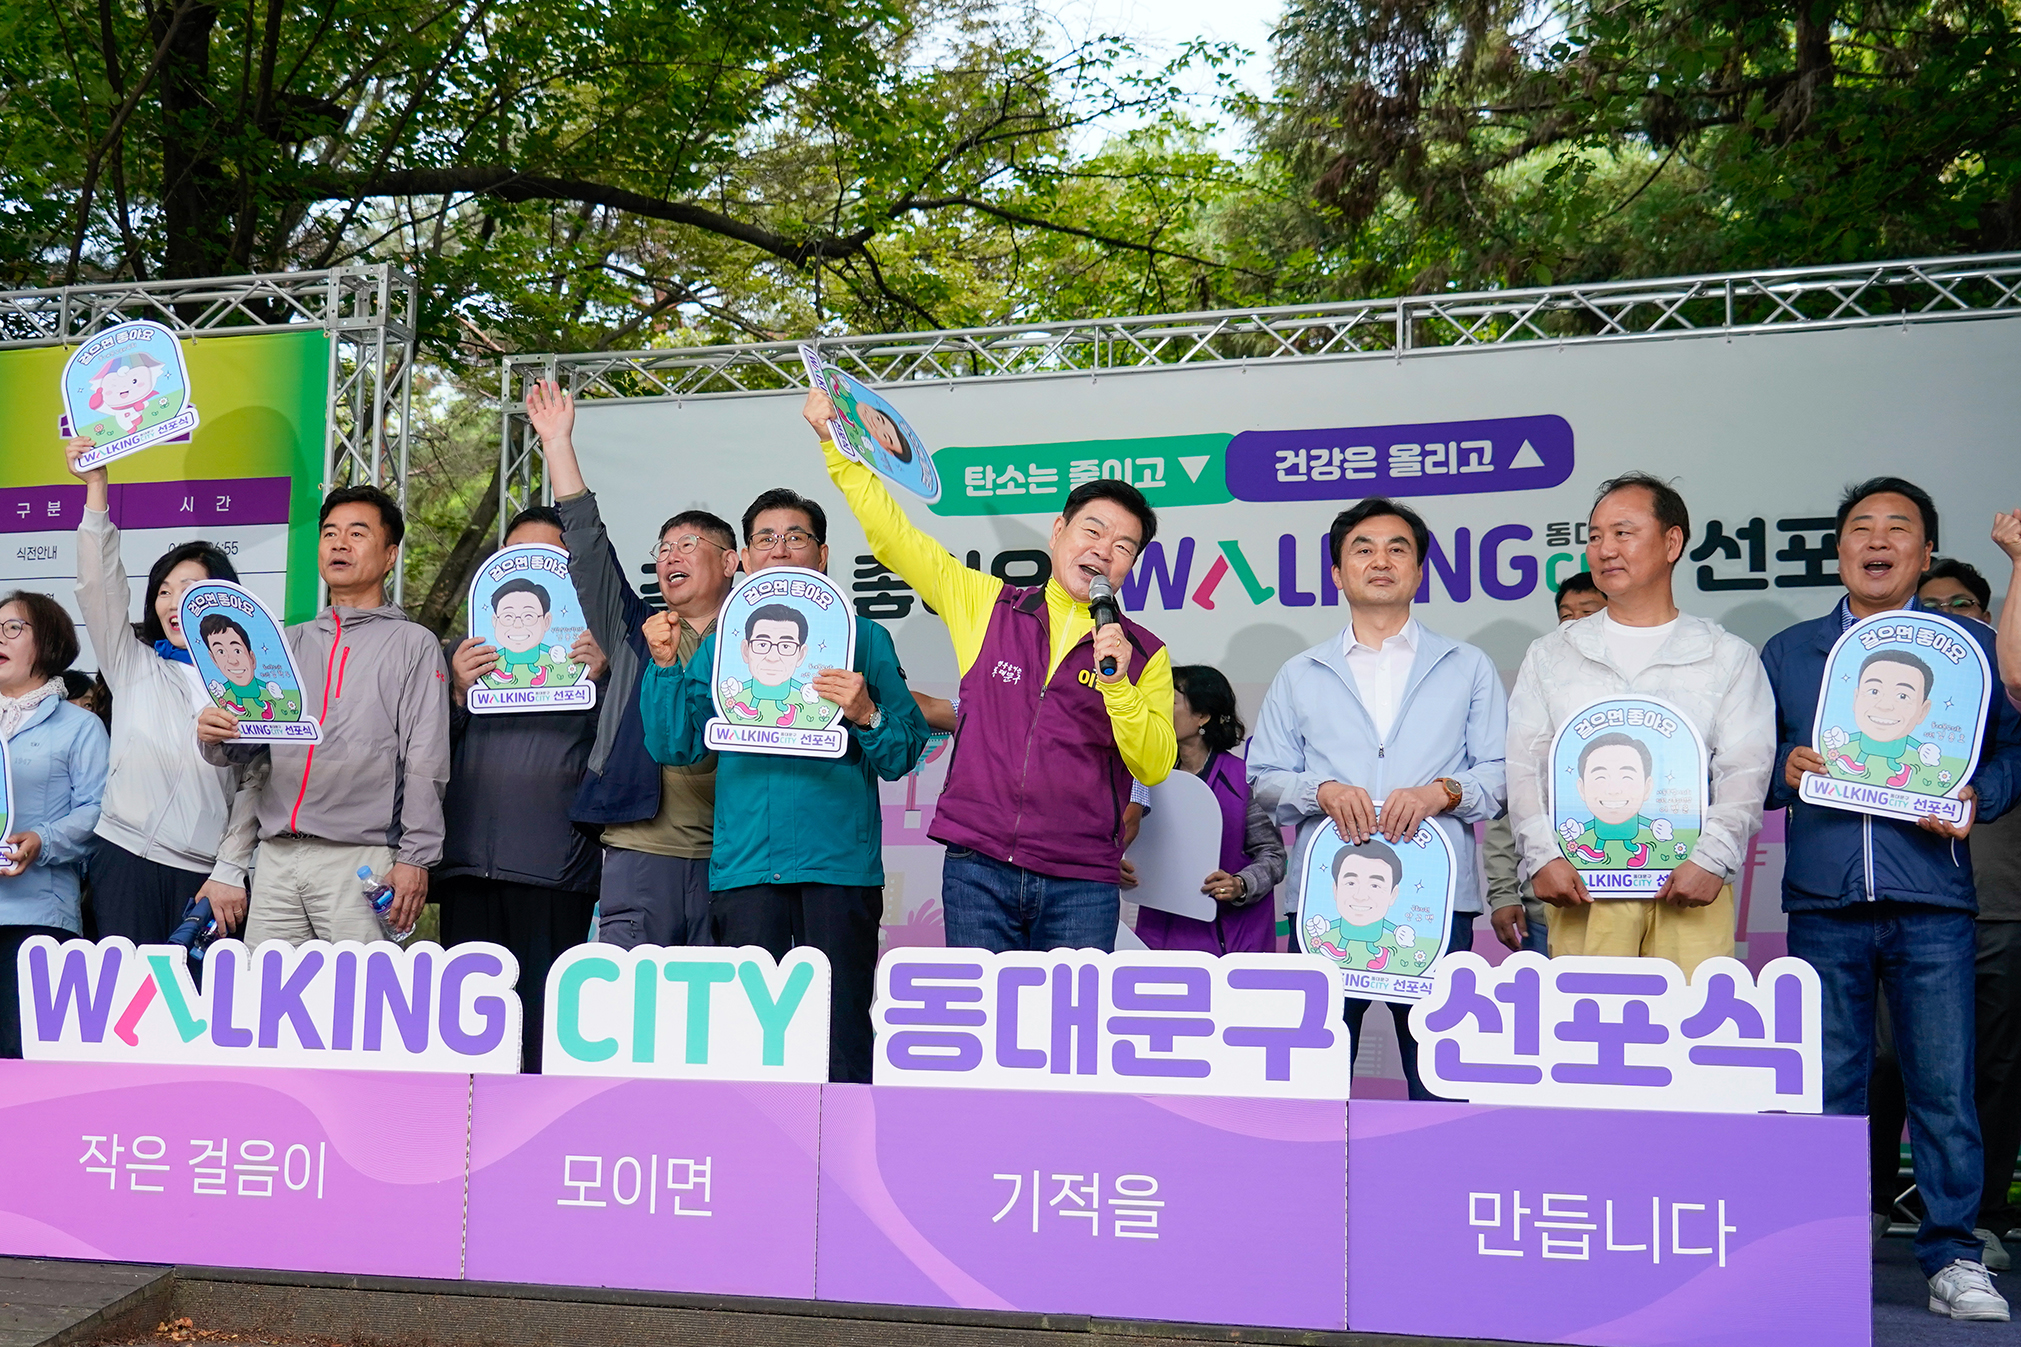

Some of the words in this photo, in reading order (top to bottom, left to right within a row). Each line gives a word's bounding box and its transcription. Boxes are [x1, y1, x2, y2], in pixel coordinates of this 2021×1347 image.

[78, 337, 115, 365] 걸으면
[116, 329, 155, 344] 좋아요
[84, 435, 140, 462] WALKING
[158, 416, 188, 434] 선포식
[965, 463, 1058, 497] 탄소는
[1069, 456, 1166, 490] 줄이고
[1275, 447, 1376, 482] 건강은
[1388, 440, 1494, 477] 올리고
[17, 545, 57, 561] 식전안내
[488, 555, 528, 582] 걸으면
[530, 555, 568, 580] 좋아요
[1120, 523, 1538, 612] WALNG
[1690, 515, 1939, 592] 선포
[187, 593, 218, 617] 걸으면
[218, 592, 256, 618] 좋아요
[743, 580, 788, 606] 걸으면
[790, 580, 834, 611] 좋아요
[1858, 624, 1914, 651] 걸으면
[1916, 626, 1968, 665] 좋아요
[478, 691, 534, 704] WALKING
[554, 689, 585, 701] 선포식
[238, 724, 271, 736] LKING
[286, 725, 312, 736] 선포식
[717, 728, 780, 744] WALKING
[780, 736, 797, 744] CITY
[800, 733, 836, 747] 선포식
[1574, 708, 1625, 740] 걸으면
[1627, 708, 1678, 740] 좋아요
[1814, 780, 1888, 806] WALKING
[1889, 799, 1909, 808] CITY
[1914, 798, 1956, 817] 선포식
[1580, 874, 1632, 887] LKING
[1370, 982, 1389, 990] CITY
[1394, 980, 1432, 995] 선포식
[29, 946, 506, 1055] WALKING
[556, 957, 814, 1066] CITY
[884, 962, 1335, 1082] 동대문구
[1425, 966, 1803, 1095] 선포식
[78, 1133, 170, 1191] 작은
[188, 1140, 326, 1199] 걸음이
[557, 1154, 713, 1217] 모이면
[992, 1169, 1165, 1239] 기적을
[1469, 1190, 1737, 1267] 만듭니다
